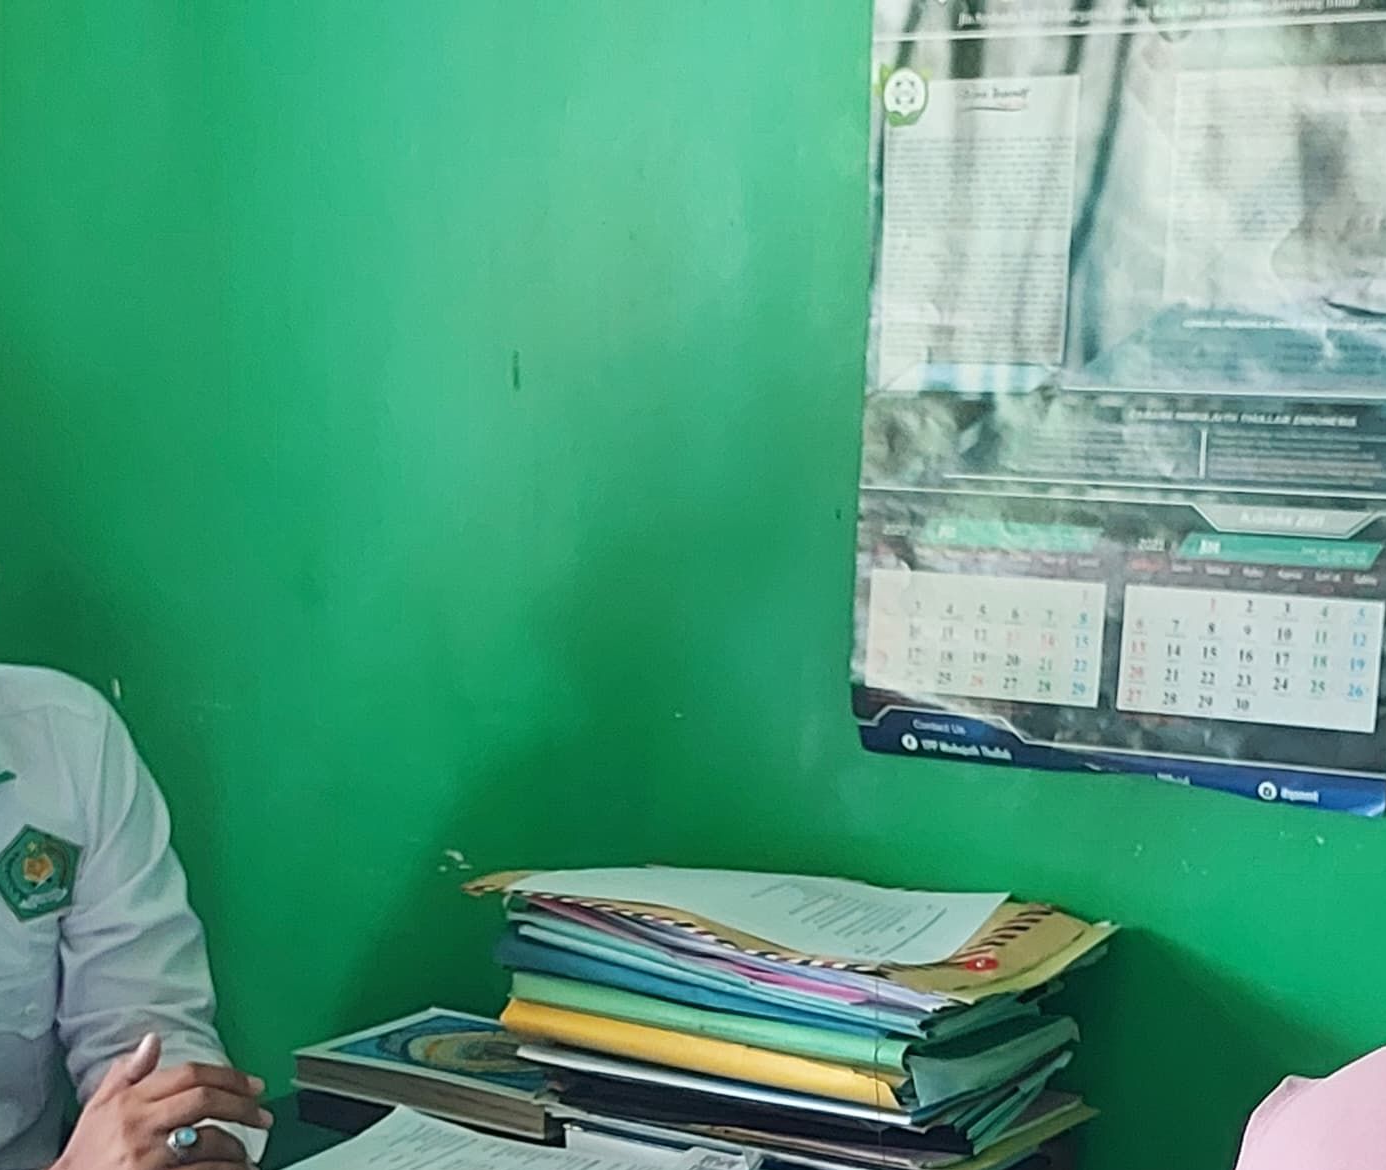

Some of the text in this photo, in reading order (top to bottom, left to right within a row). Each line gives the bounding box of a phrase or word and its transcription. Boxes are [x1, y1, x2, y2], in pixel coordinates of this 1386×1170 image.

[1246, 600, 1253, 612] 2
[1172, 620, 1179, 631] 7
[1208, 622, 1215, 633] 8
[1244, 625, 1251, 635] 9
[1277, 628, 1292, 639] 10
[1315, 631, 1327, 643] 11
[1352, 634, 1365, 645] 12
[1167, 644, 1181, 657] 14
[1202, 646, 1217, 659] 15
[1239, 649, 1253, 662] 16
[1275, 652, 1290, 665] 17
[1312, 655, 1327, 667] 18
[1350, 658, 1365, 671] 19
[1128, 666, 1363, 696] 20 21 22 23 24 25 26
[1127, 690, 1250, 710] 27 28 29 30
